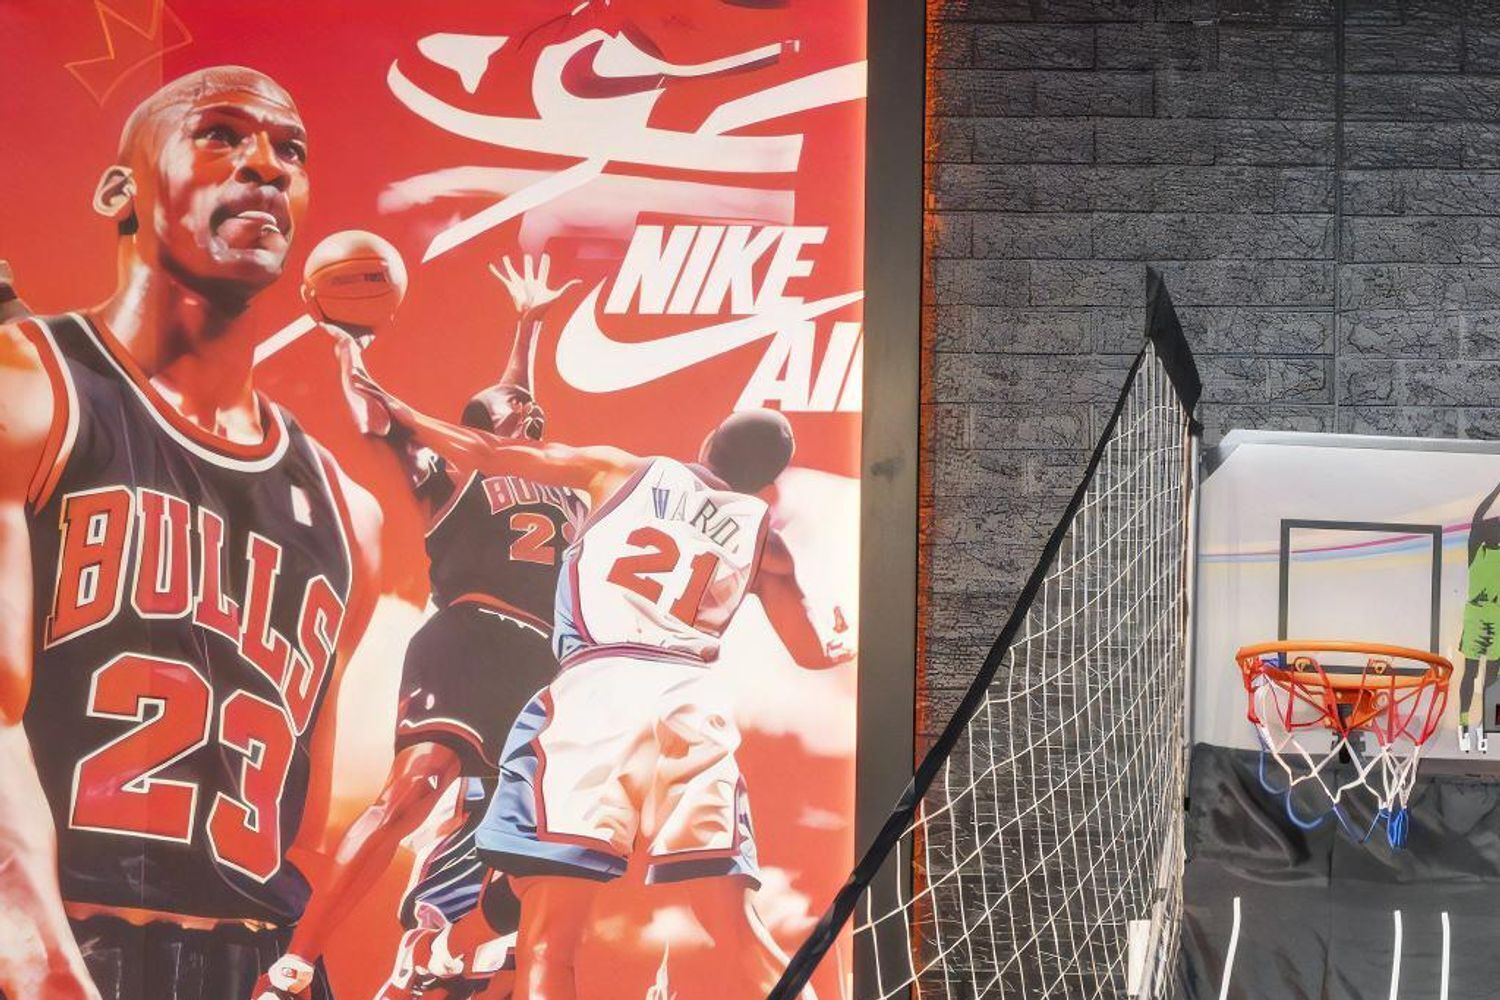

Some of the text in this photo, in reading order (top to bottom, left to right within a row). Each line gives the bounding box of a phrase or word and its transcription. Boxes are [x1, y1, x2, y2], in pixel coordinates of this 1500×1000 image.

[603, 224, 829, 316] NIKE
[44, 485, 346, 737] BULLS
[606, 526, 720, 628] 21
[69, 651, 297, 884] 23
